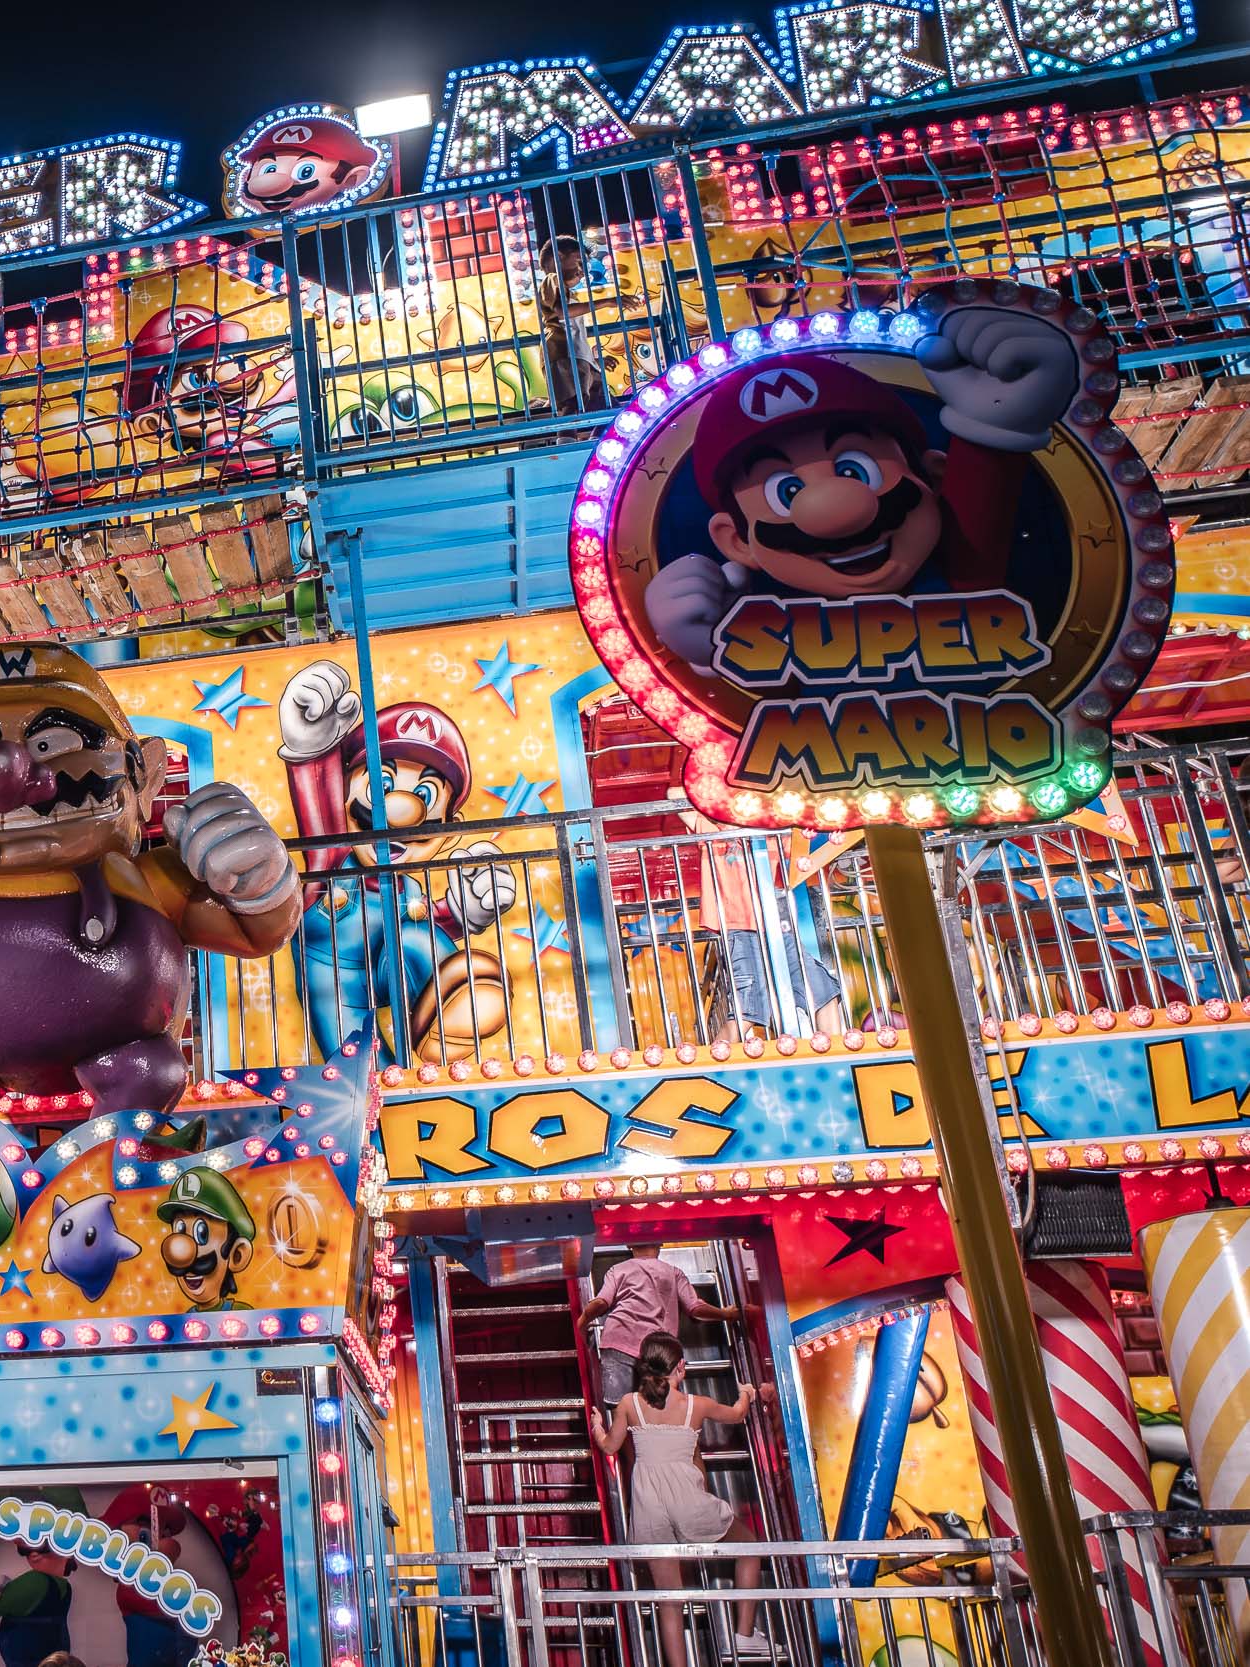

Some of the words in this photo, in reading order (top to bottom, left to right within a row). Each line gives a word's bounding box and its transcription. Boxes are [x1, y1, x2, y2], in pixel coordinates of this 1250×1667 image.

[423, 0, 1195, 191] MARIO
[751, 370, 815, 418] M
[717, 594, 1047, 681] SUPER
[399, 711, 437, 740] M
[730, 694, 1058, 787] MARIO
[379, 1075, 743, 1180] ROS
[1144, 1036, 1250, 1132] L
[27, 1502, 219, 1632] PUBLICOS
